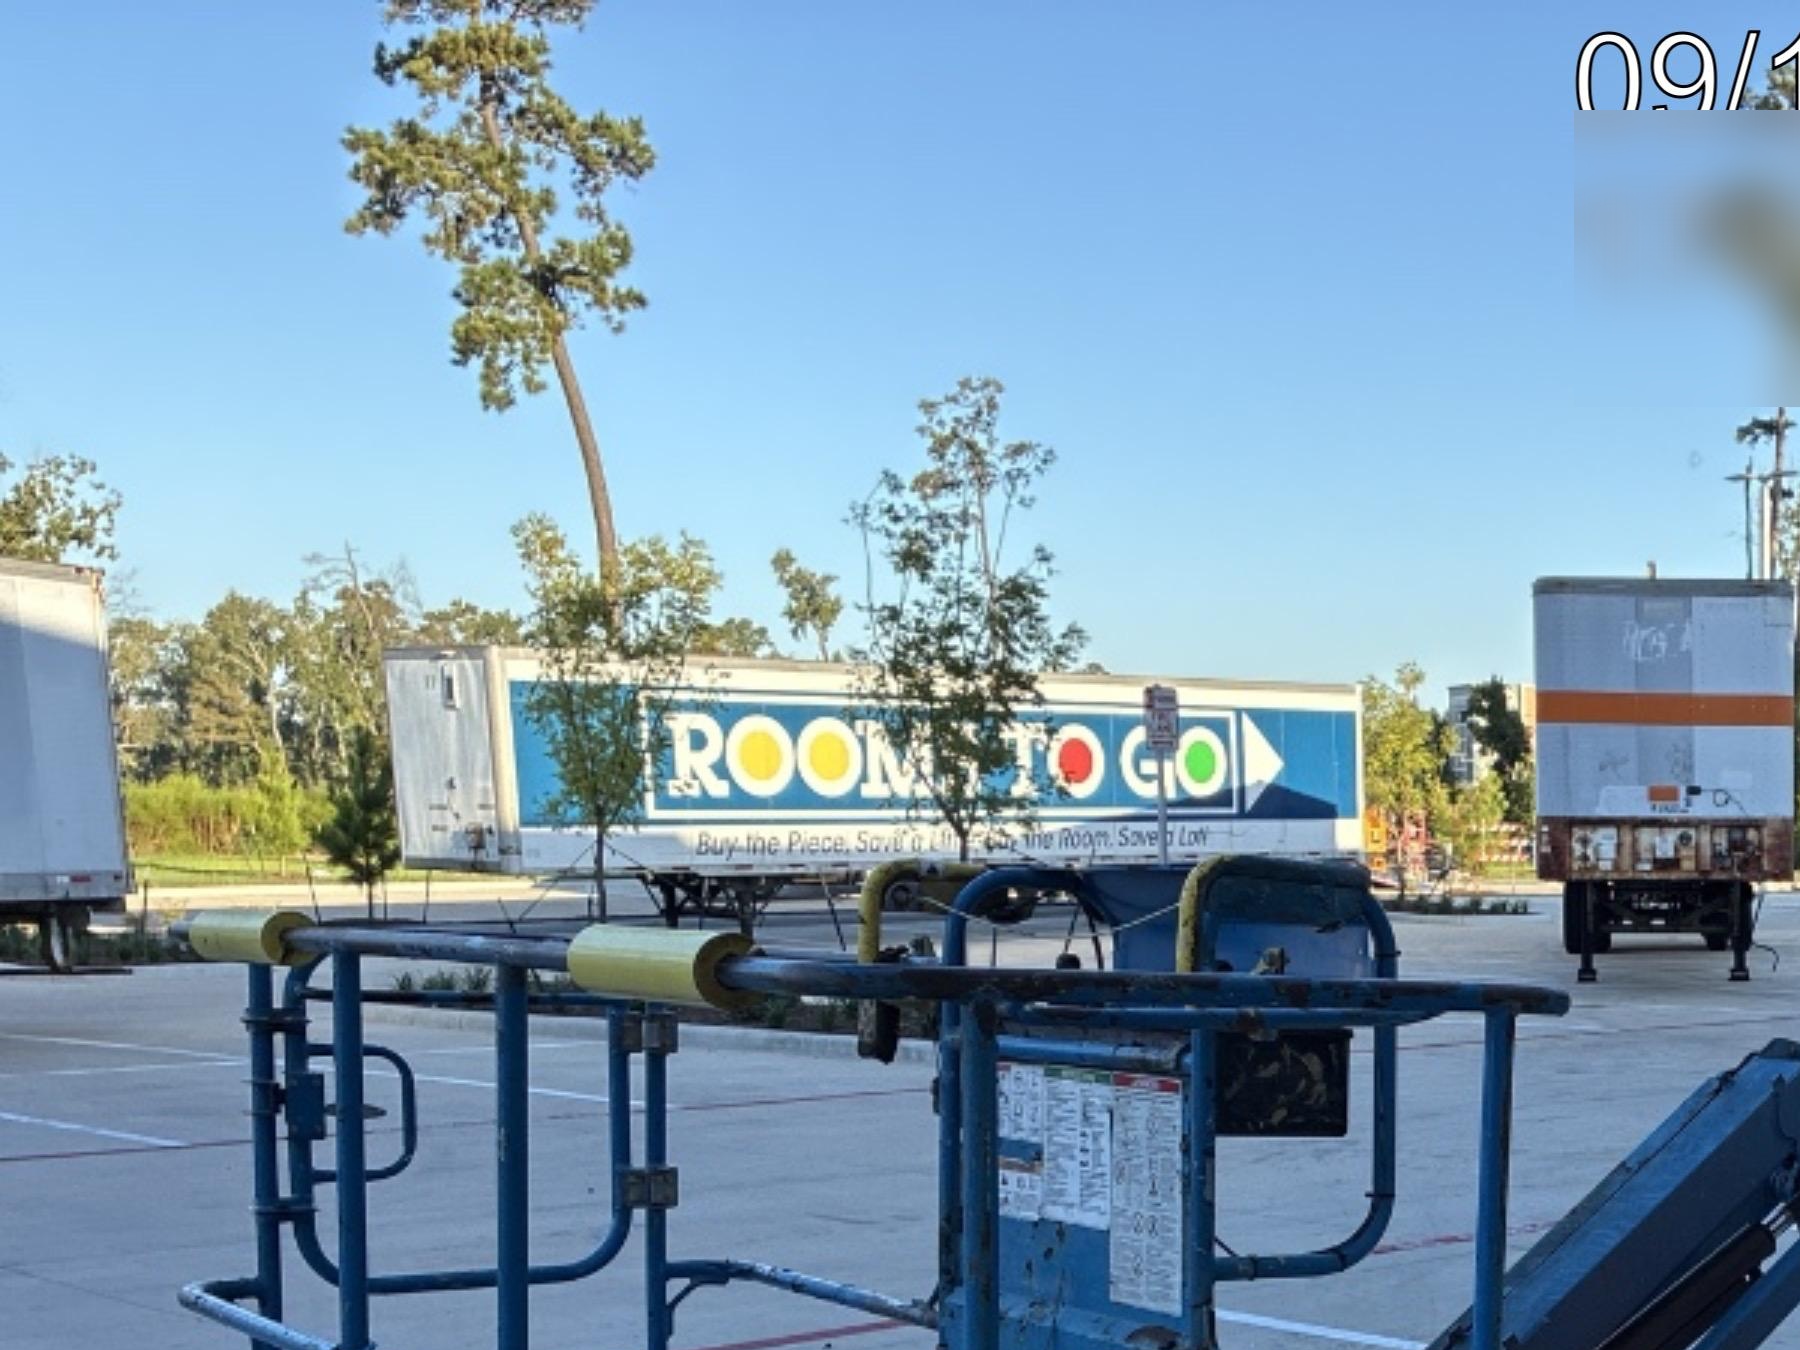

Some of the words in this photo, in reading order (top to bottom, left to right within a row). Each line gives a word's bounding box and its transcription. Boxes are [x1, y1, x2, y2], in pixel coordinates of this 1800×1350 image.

[999, 722, 1105, 799] TO
[1119, 724, 1228, 800] GO
[696, 831, 738, 861] Buy
[746, 831, 780, 856] the
[1118, 827, 1158, 850] Save
